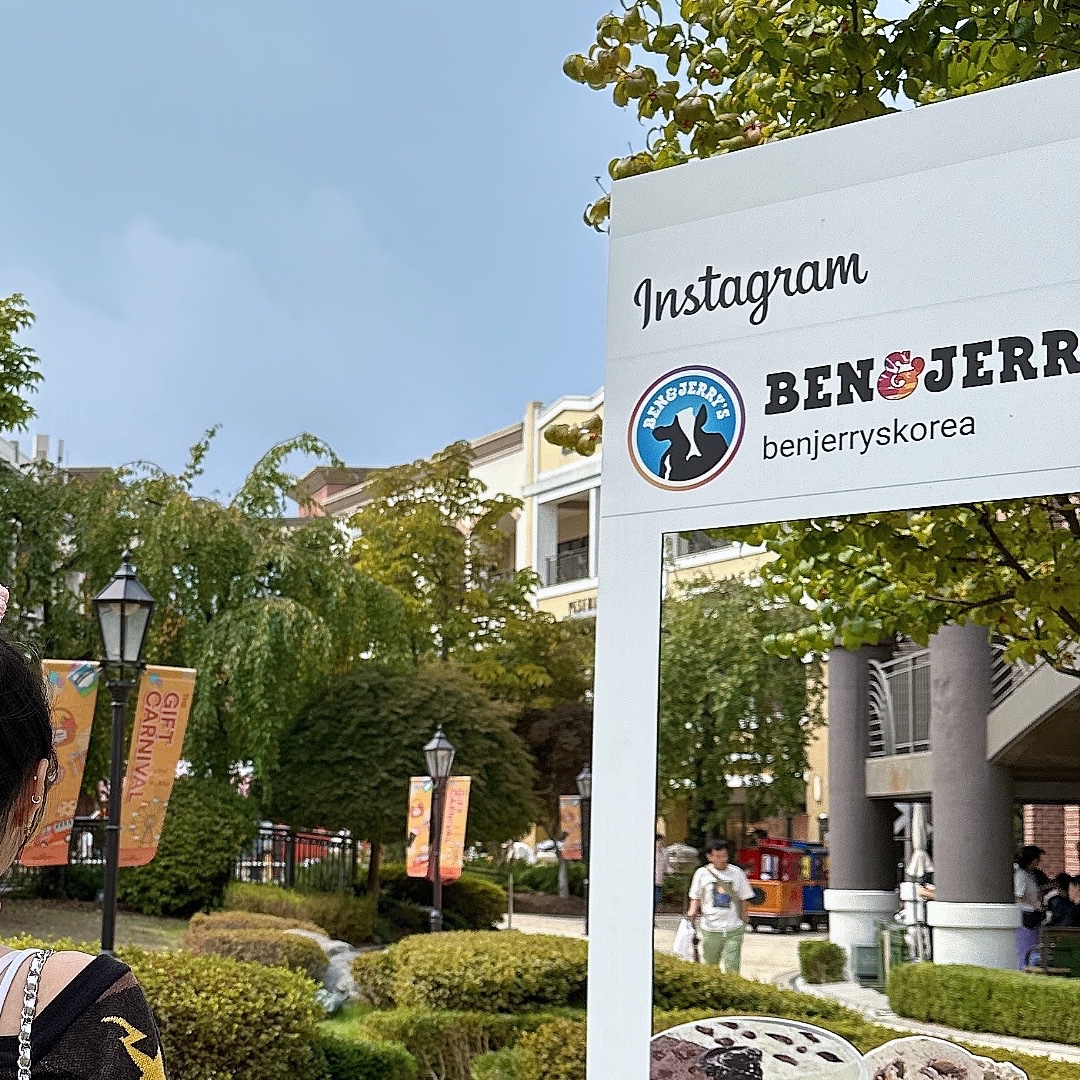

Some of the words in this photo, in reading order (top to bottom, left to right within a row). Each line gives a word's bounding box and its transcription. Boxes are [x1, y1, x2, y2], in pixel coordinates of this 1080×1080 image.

[633, 252, 869, 330] Instagram
[642, 381, 731, 430] BEN&JERRY'S
[763, 416, 976, 461] benjerryskorea
[157, 691, 180, 745] GIFT
[128, 690, 162, 802] CARNIVAL
